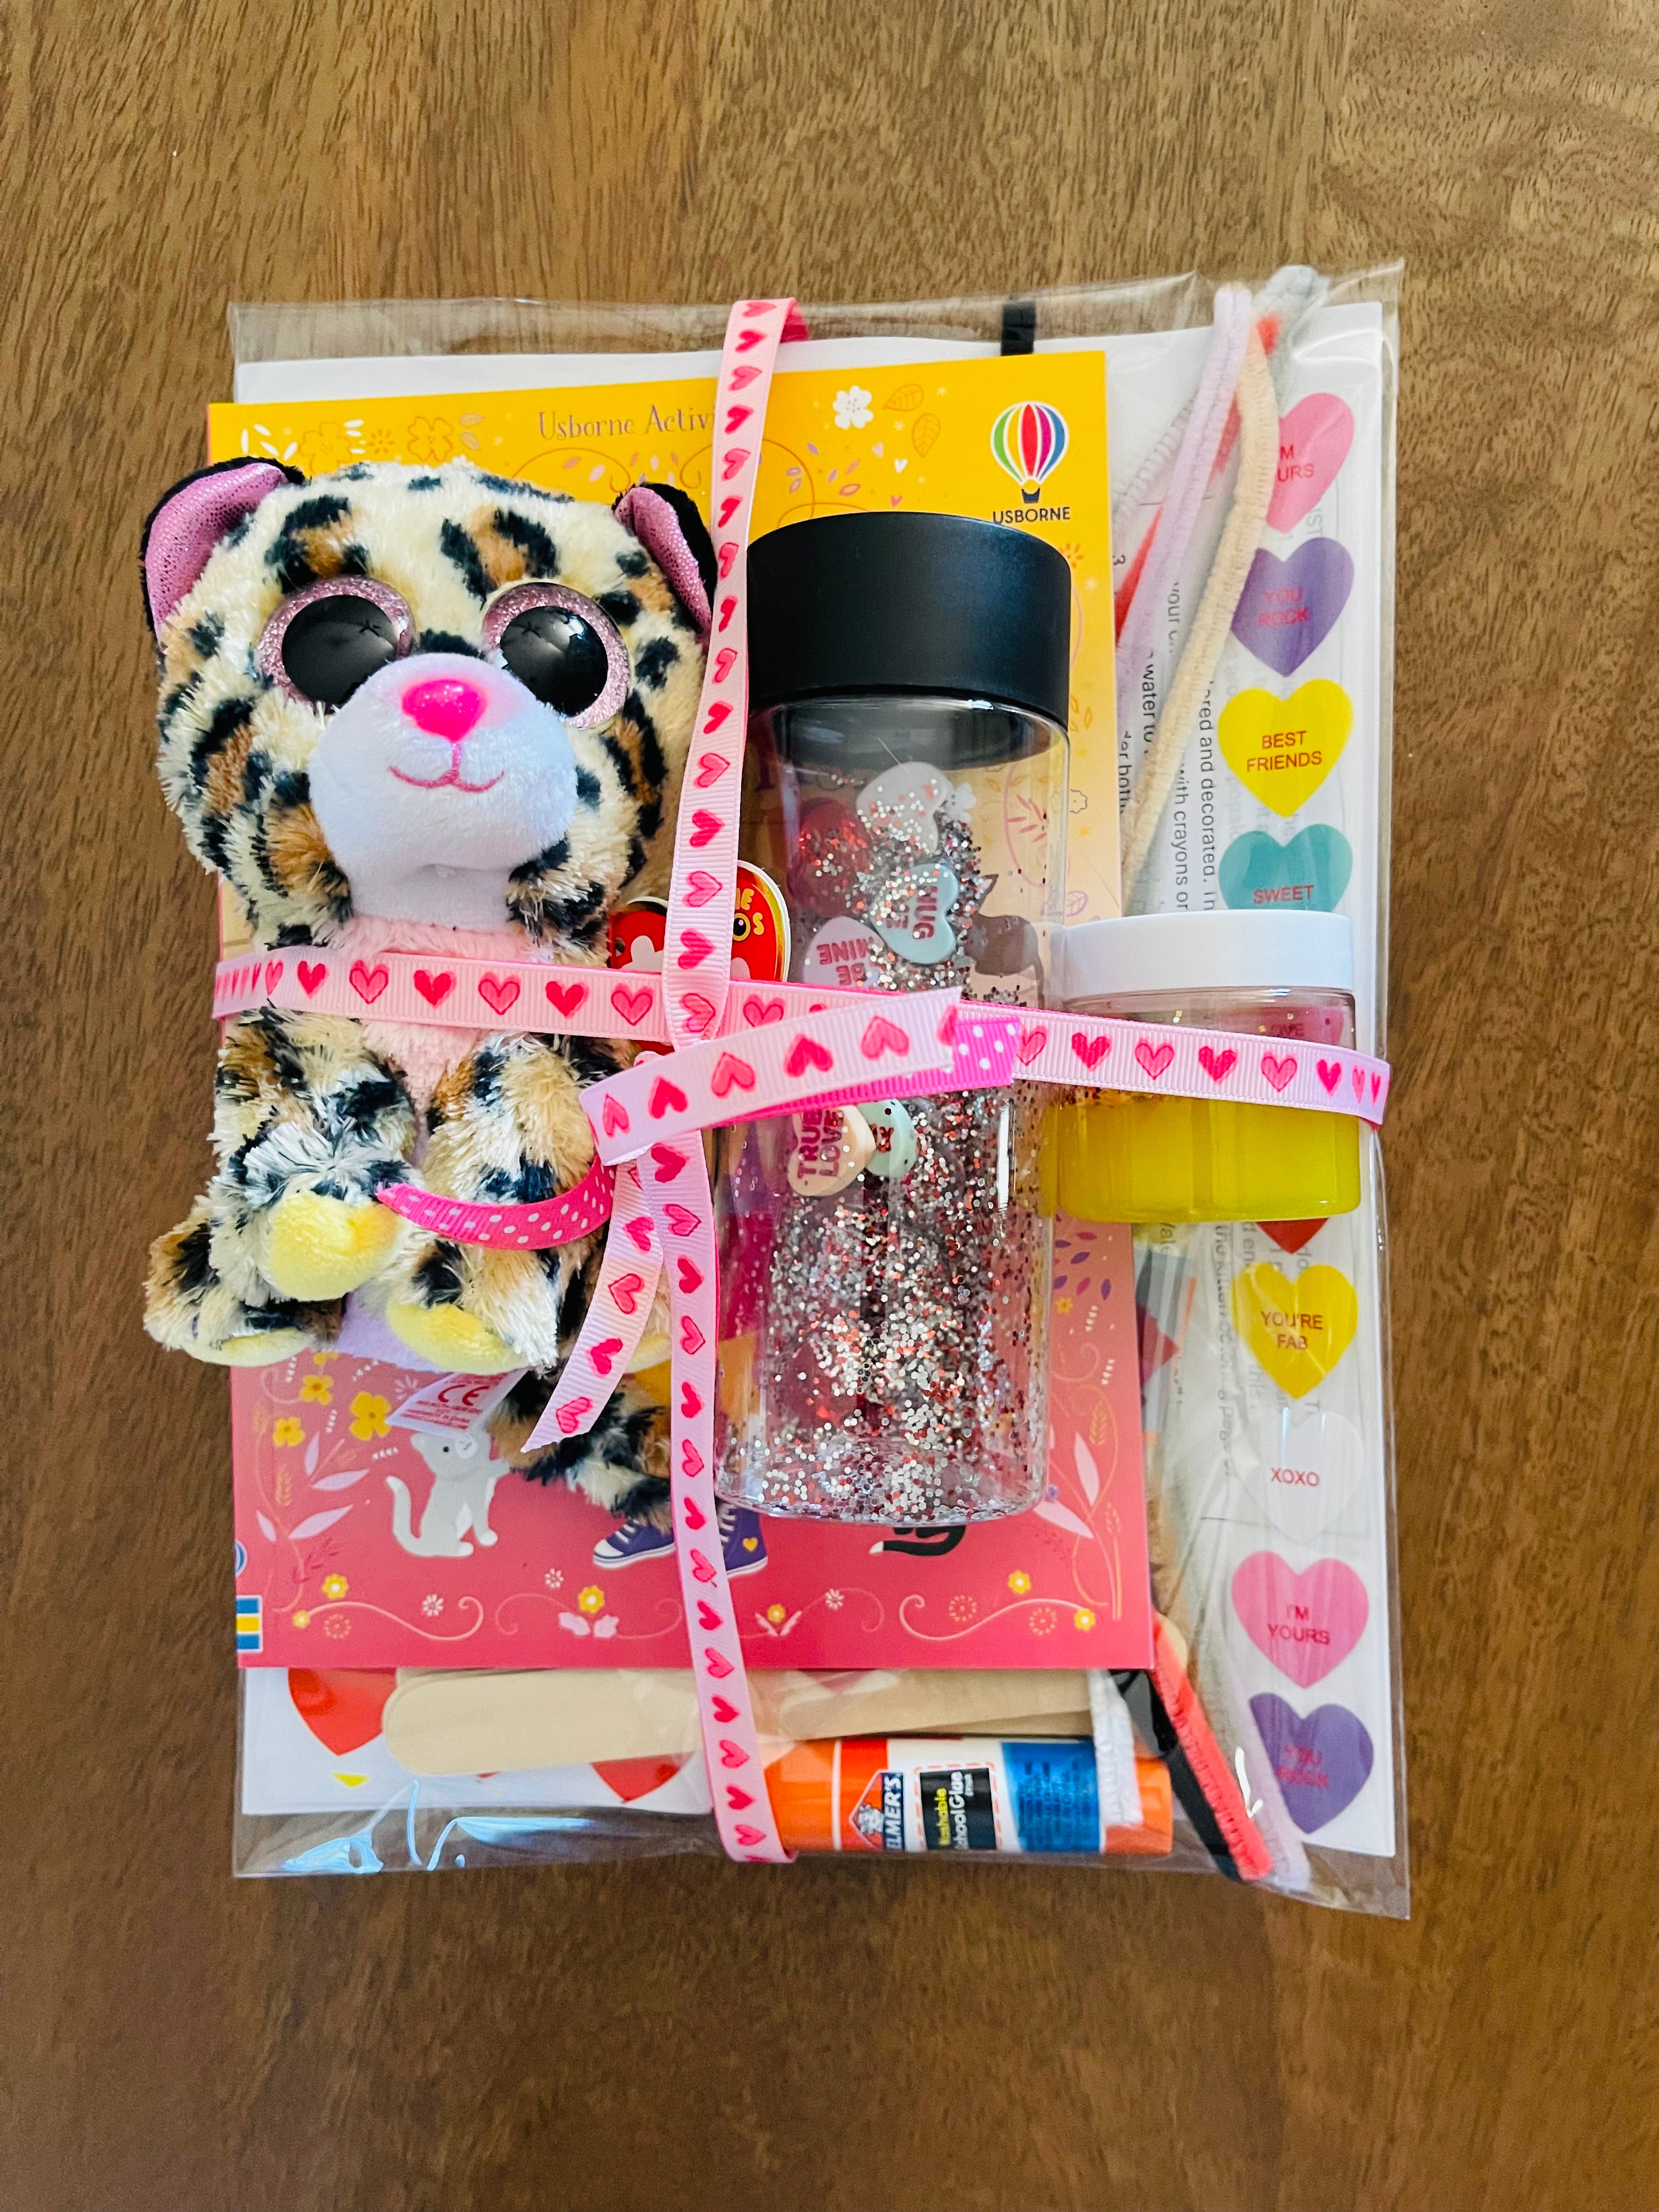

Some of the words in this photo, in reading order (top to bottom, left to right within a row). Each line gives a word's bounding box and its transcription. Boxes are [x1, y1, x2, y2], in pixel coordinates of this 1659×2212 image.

[539, 410, 635, 441] Usborne
[993, 506, 1070, 524] USBORNE
[1142, 664, 1157, 719] water
[1262, 731, 1307, 750] BEST
[1199, 737, 1214, 773] and
[1246, 750, 1323, 772] FRIENDS
[1171, 810, 1189, 886] crayons
[1175, 892, 1188, 910] or
[1253, 884, 1314, 905] SWEET
[798, 1109, 822, 1179] TRUE
[819, 1110, 843, 1177] LOVE
[1260, 1310, 1324, 1330] YOU'RE
[1277, 1333, 1308, 1351] FAB
[1271, 1467, 1320, 1487] XOXO
[1267, 1622, 1331, 1645] YOURS
[883, 1775, 902, 1849] ELMER'S
